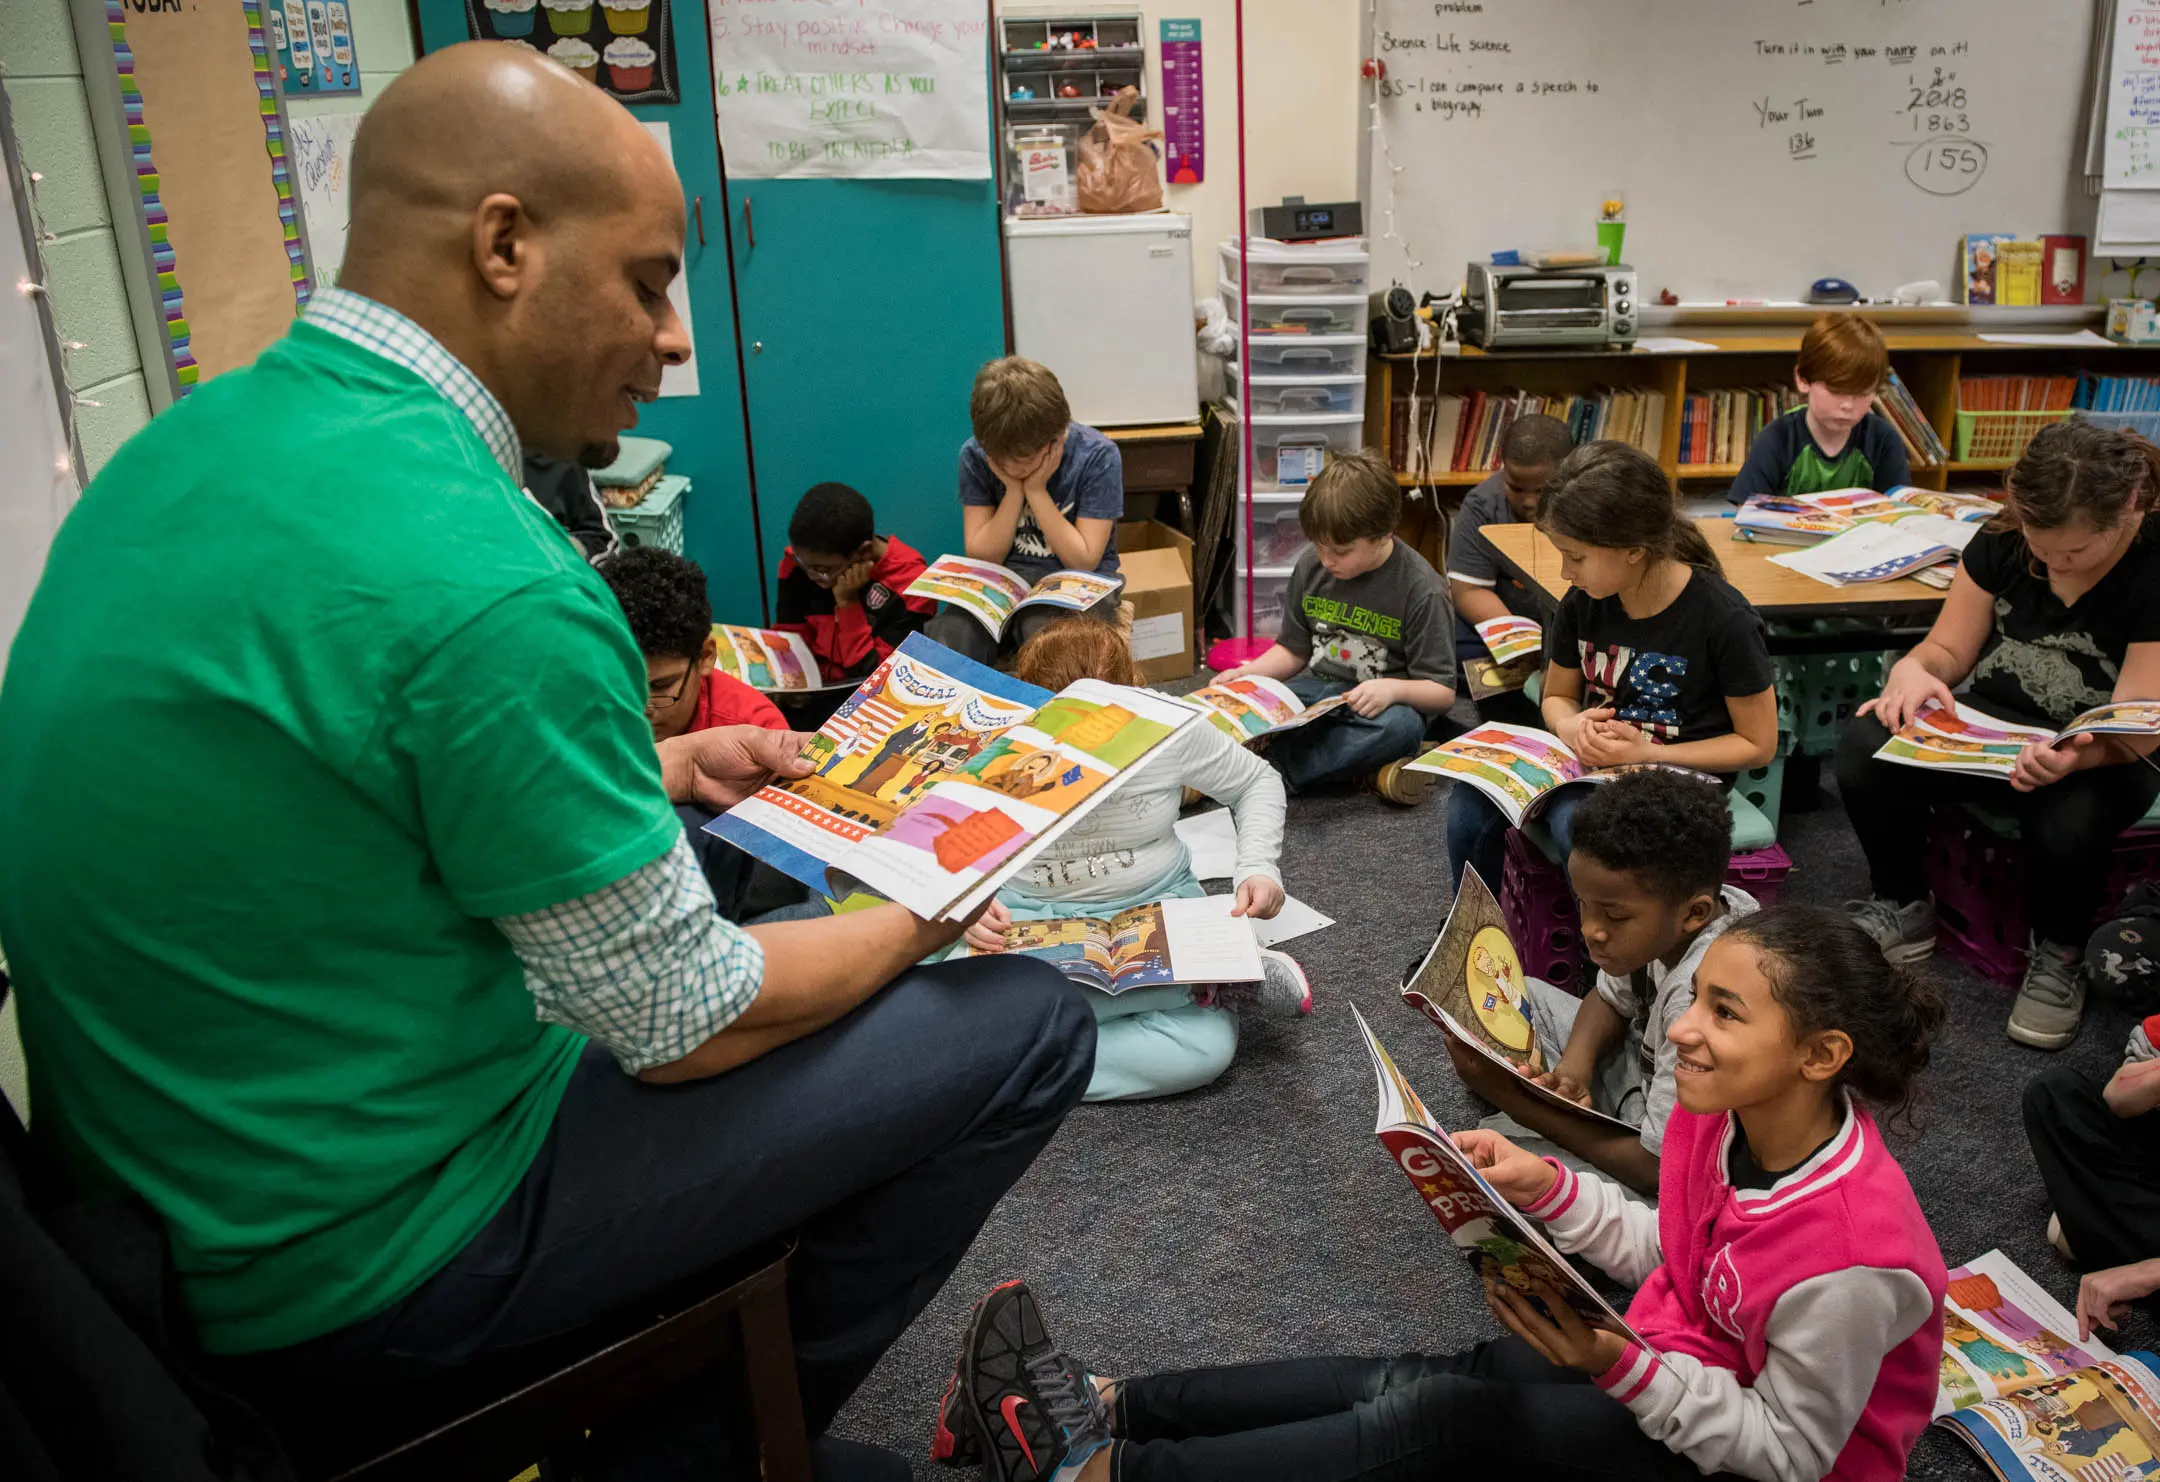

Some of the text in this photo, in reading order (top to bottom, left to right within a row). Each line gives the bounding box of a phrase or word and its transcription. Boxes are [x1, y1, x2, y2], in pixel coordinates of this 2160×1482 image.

[1434, 2, 1484, 16] problem
[742, 14, 788, 49] Stay
[877, 12, 945, 44] Change
[807, 37, 877, 57] mindset
[1437, 33, 1461, 53] Life
[1469, 39, 1512, 53] science
[1754, 40, 1785, 55] Turn
[1885, 46, 1918, 57] name
[1930, 46, 1946, 57] on
[884, 72, 902, 94] AS
[908, 76, 936, 94] YOU
[1430, 81, 1448, 93] can
[1456, 82, 1504, 96] compare
[1516, 82, 1525, 93] a
[1587, 80, 1600, 93] to
[1753, 95, 1825, 128] Your Turn
[1789, 132, 1816, 151] 136
[1924, 147, 1978, 174] 155
[1302, 595, 1401, 640] CHALLENGE
[895, 664, 958, 700] SPECIAL
[966, 697, 1014, 727] ELECTION
